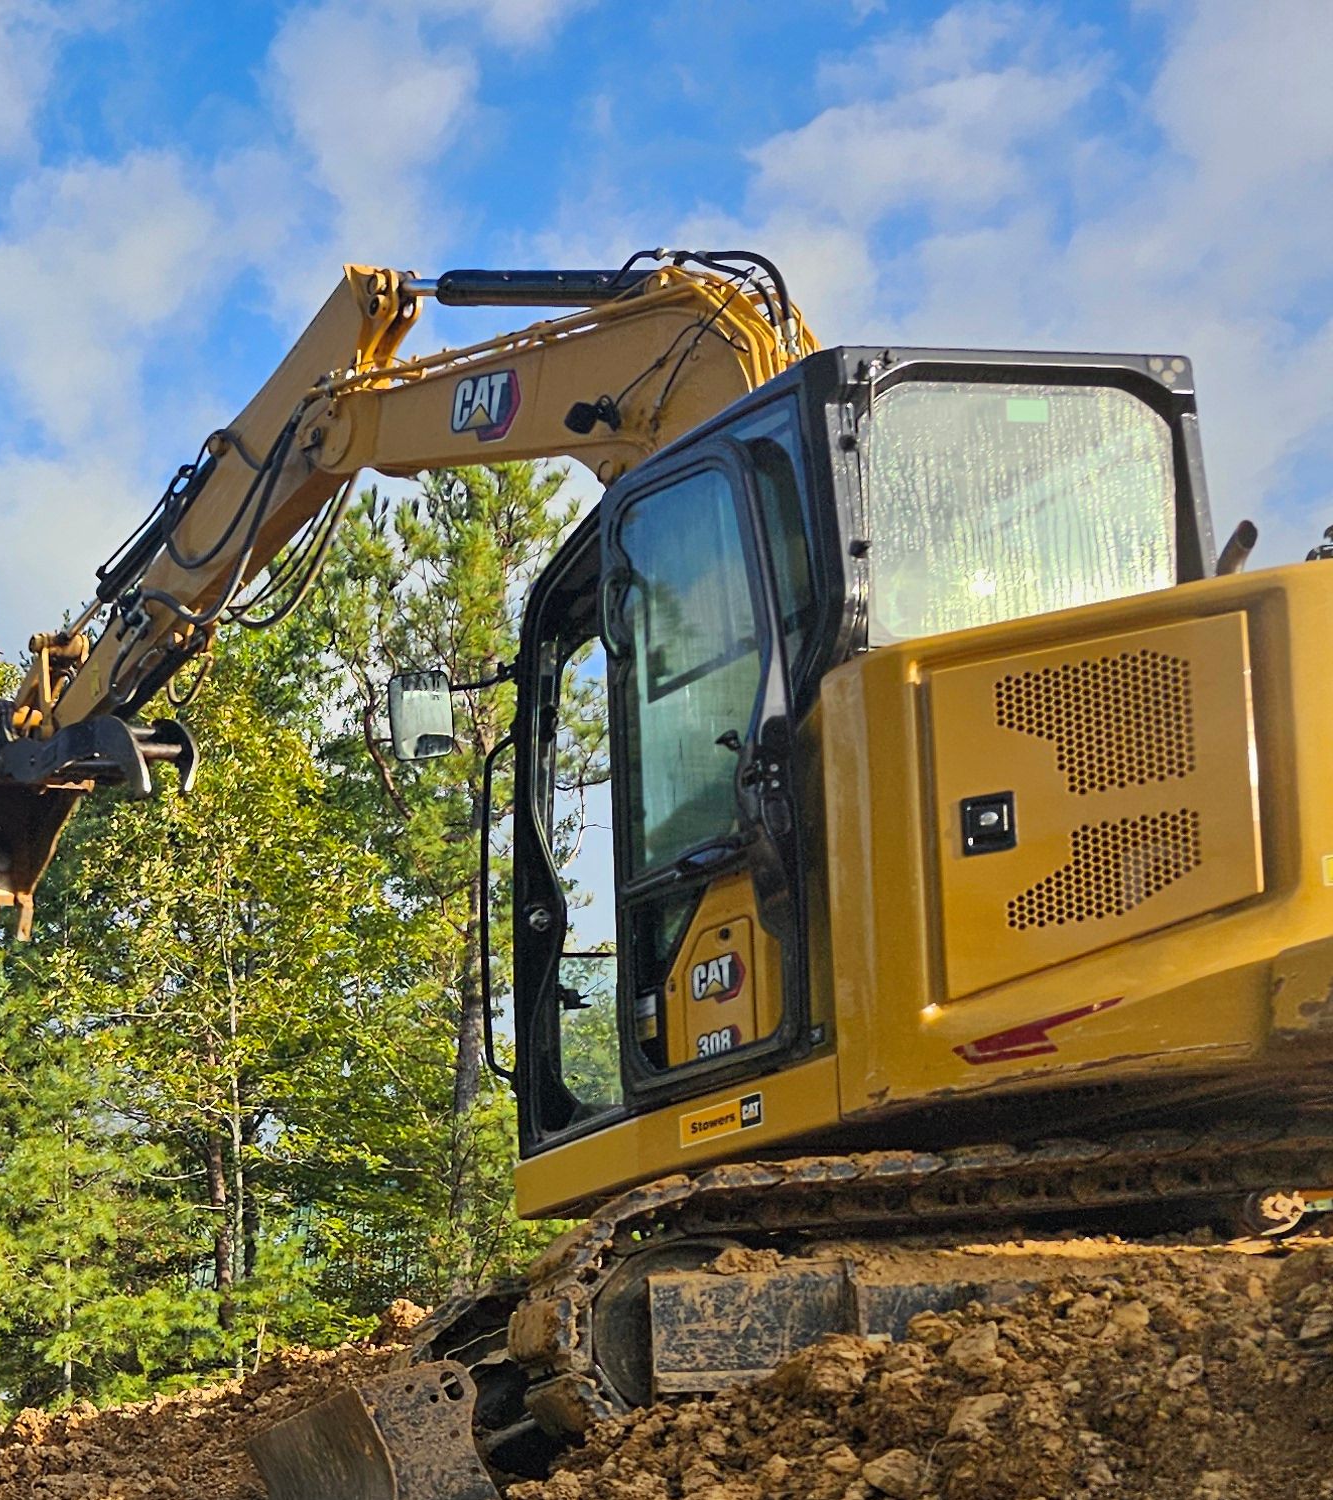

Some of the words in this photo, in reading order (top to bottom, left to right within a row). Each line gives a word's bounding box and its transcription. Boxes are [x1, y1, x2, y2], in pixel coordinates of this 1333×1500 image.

[452, 372, 509, 432] CAT
[693, 954, 733, 1000] CAT
[698, 1028, 732, 1058] 308
[690, 1112, 737, 1135] Stowers
[742, 1101, 761, 1121] CAT
